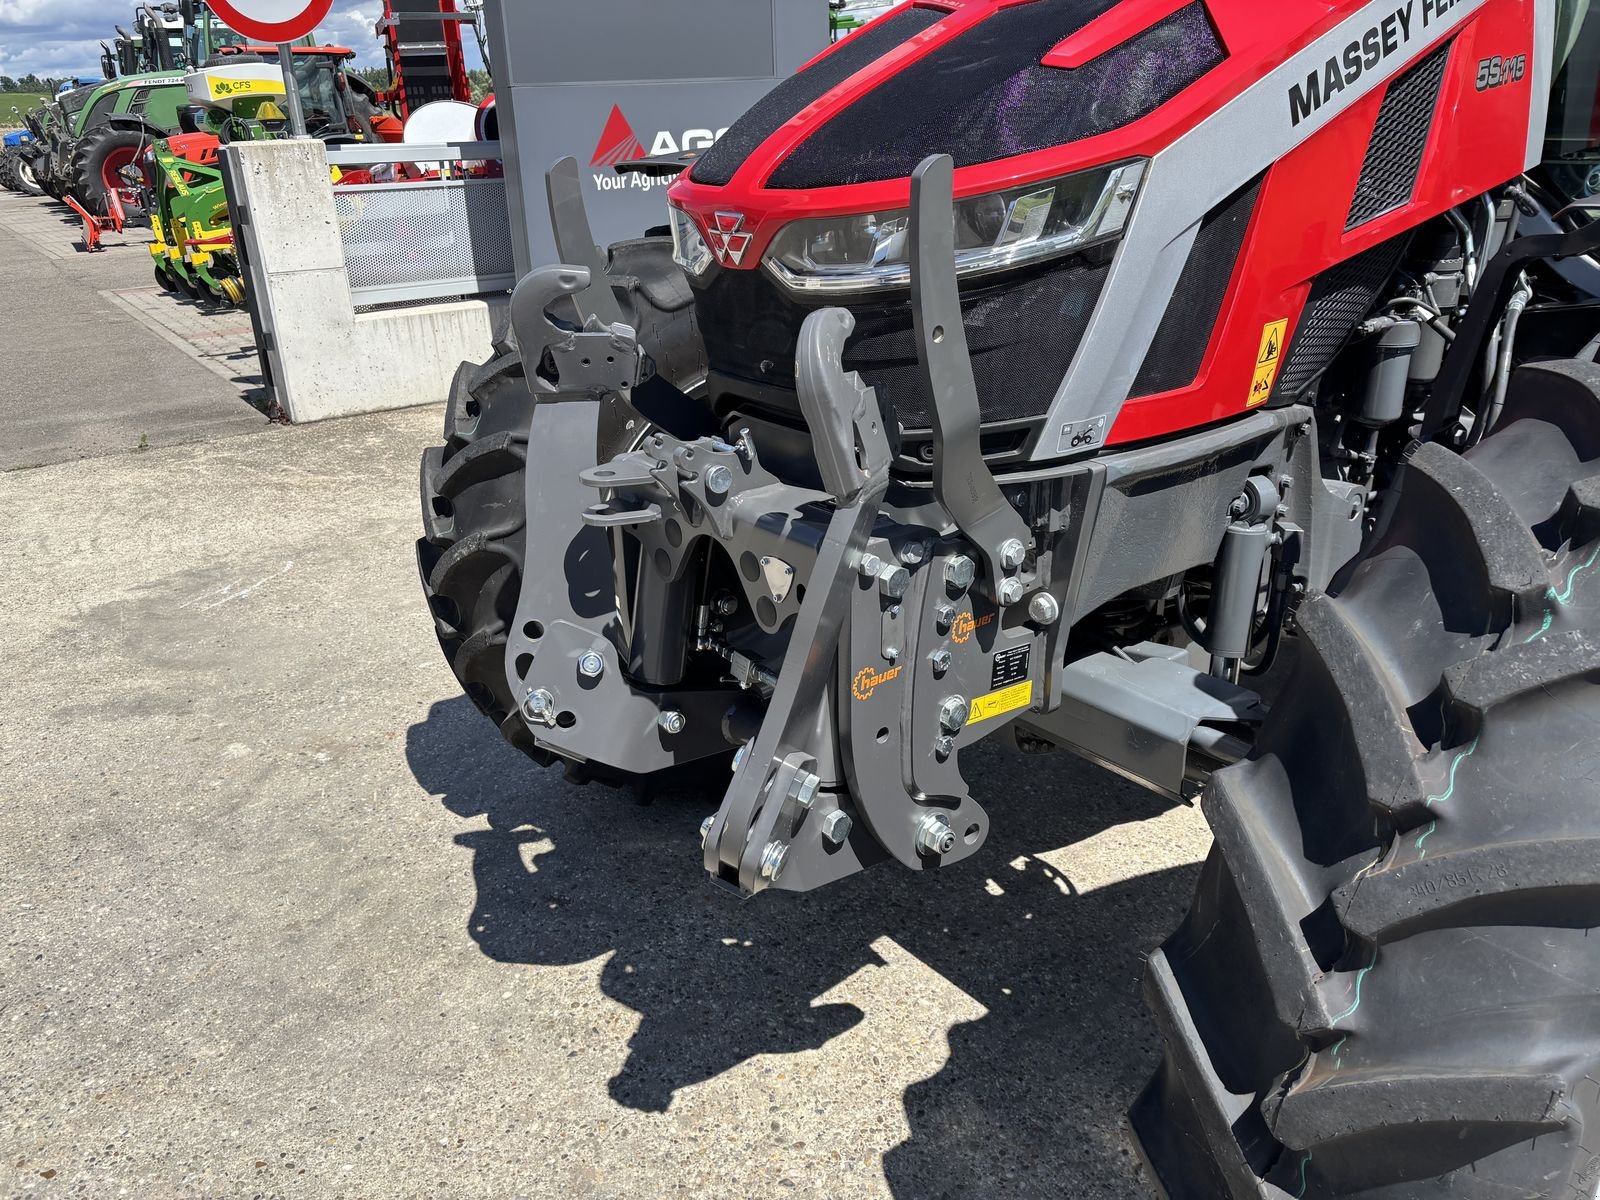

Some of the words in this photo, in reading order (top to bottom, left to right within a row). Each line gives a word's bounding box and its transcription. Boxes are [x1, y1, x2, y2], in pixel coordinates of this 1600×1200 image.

[1288, 0, 1413, 127] MASSEY
[233, 81, 251, 89] CFS
[593, 174, 627, 190] Your
[958, 613, 996, 635] hauer
[861, 666, 902, 691] hauer
